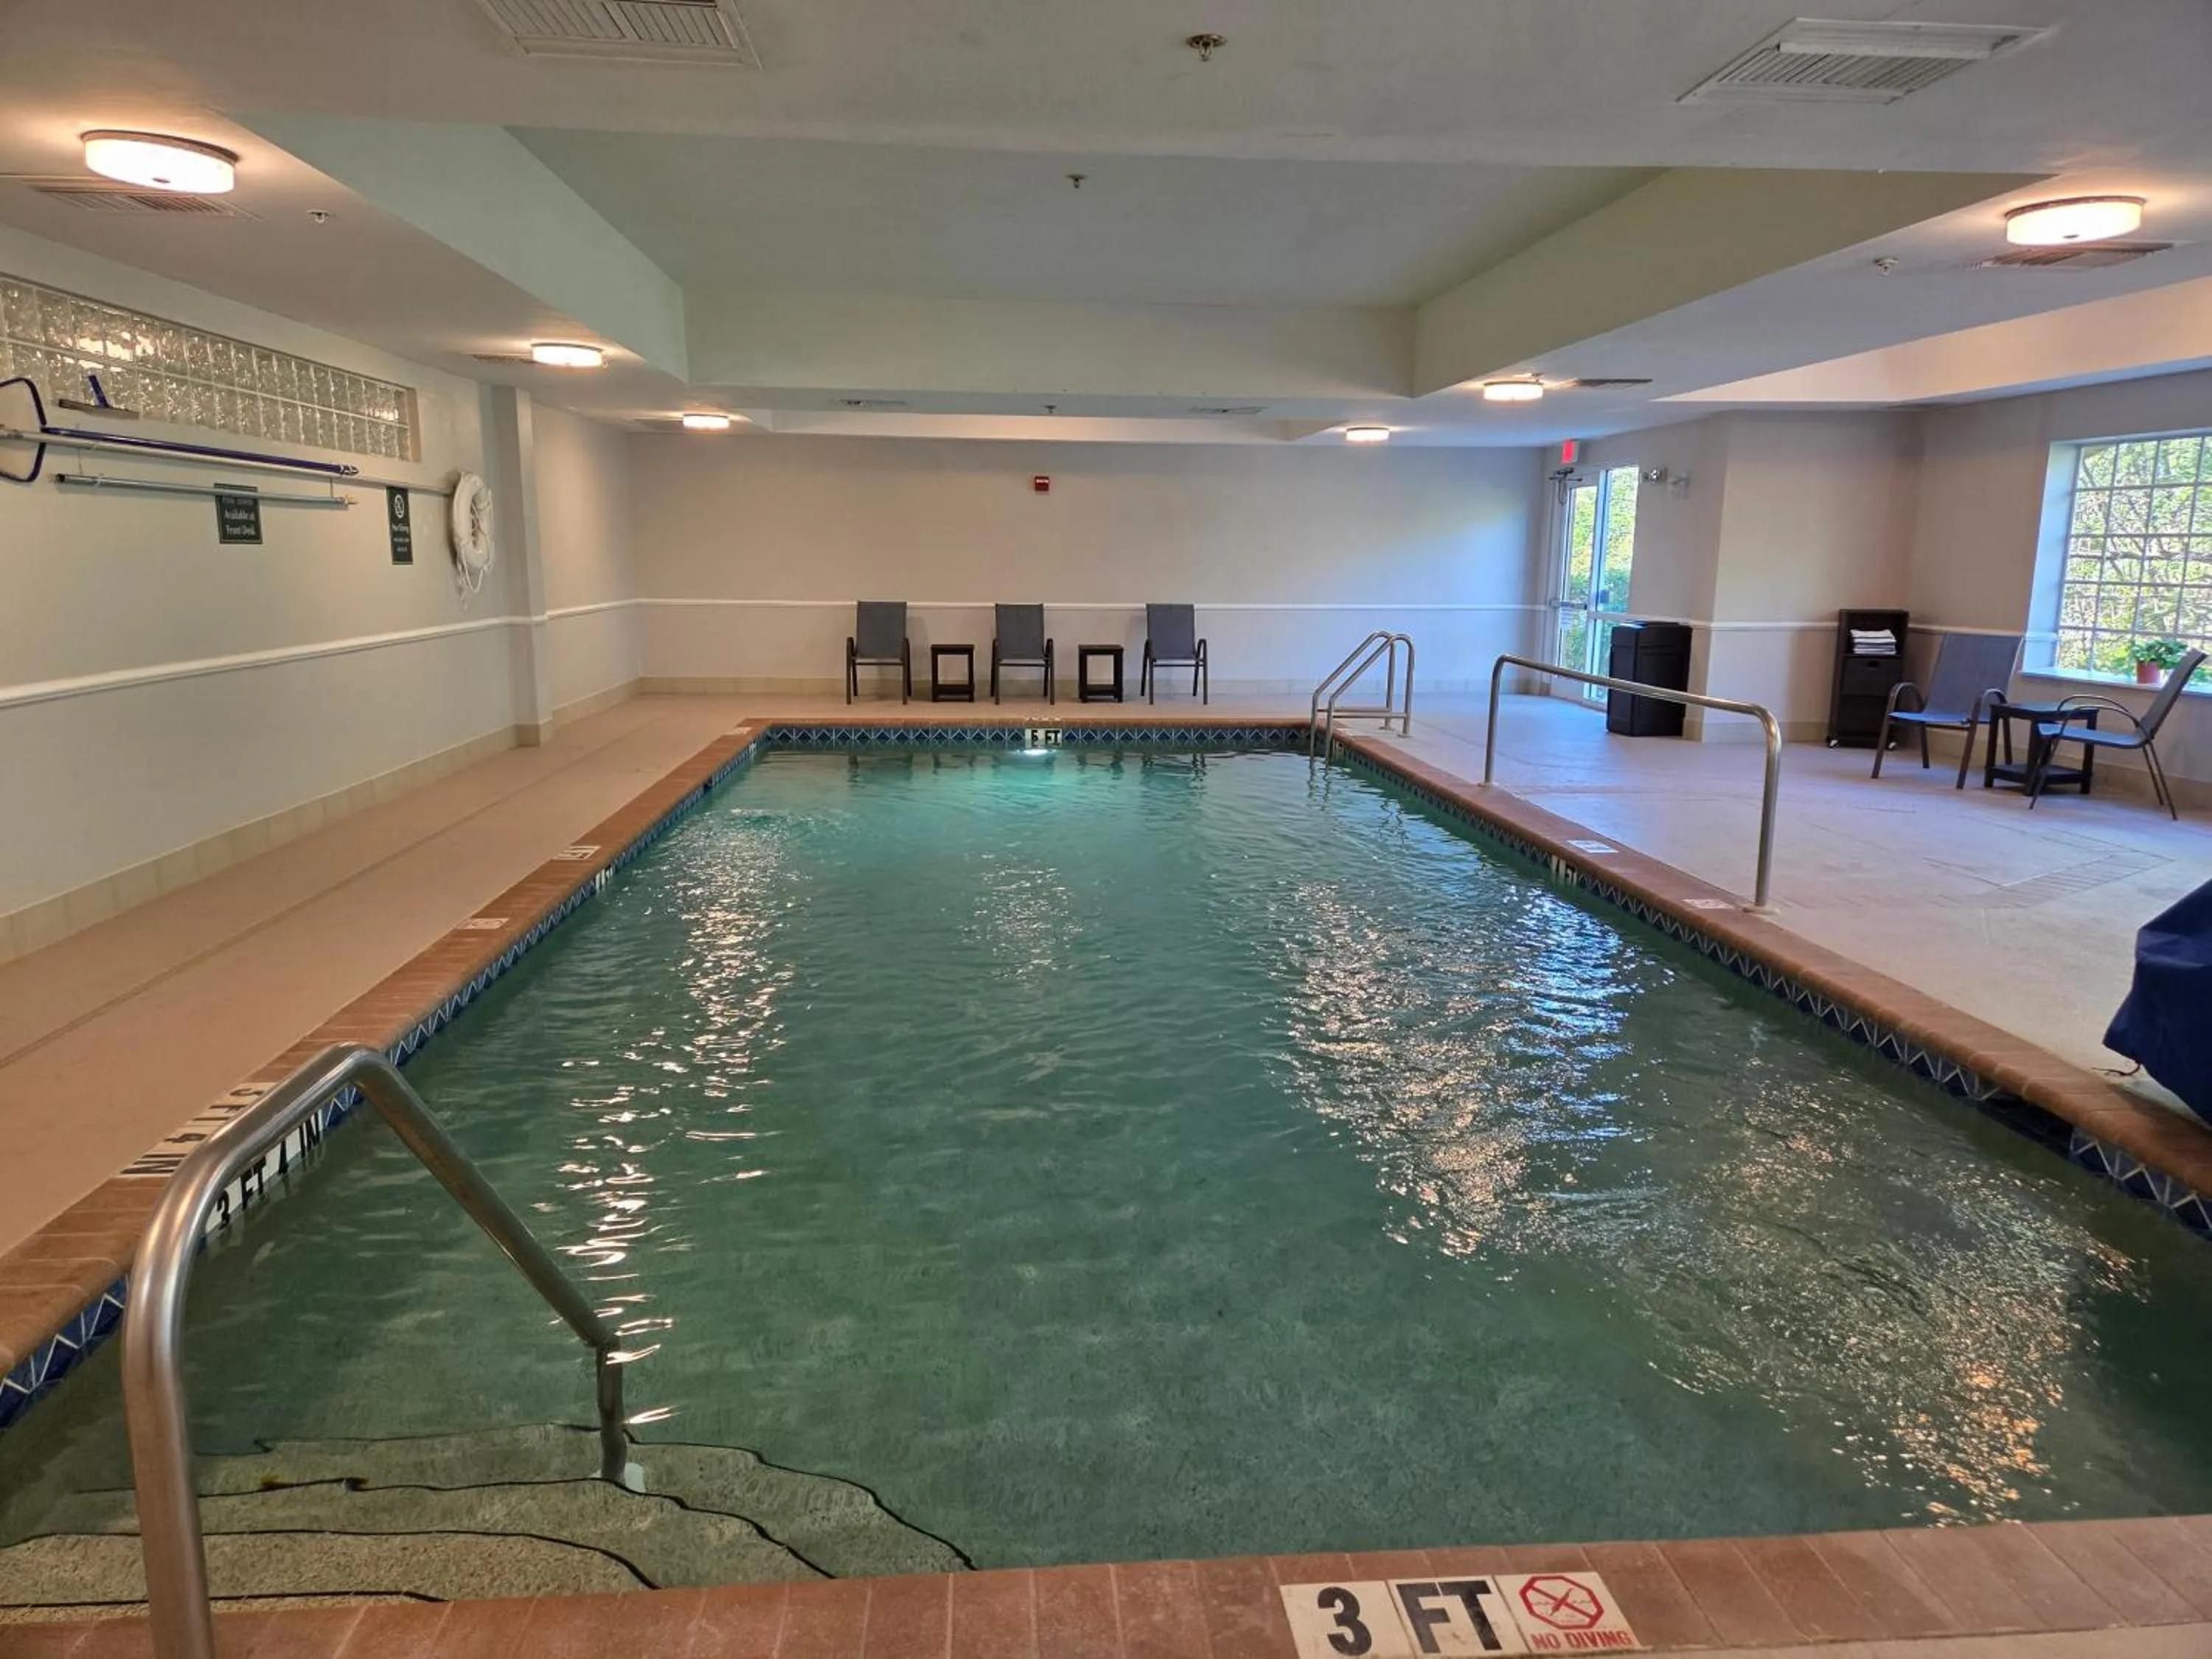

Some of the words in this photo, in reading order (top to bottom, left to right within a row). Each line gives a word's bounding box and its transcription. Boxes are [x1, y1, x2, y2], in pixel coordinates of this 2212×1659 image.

[1046, 729, 1060, 745] FT
[217, 1189, 231, 1231] 3
[240, 1155, 267, 1211] FT
[299, 1110, 320, 1158] IN
[1318, 1586, 1372, 1656] 3
[1396, 1579, 1503, 1654] FT
[1530, 1632, 1562, 1649] NO
[1563, 1630, 1634, 1649] DIVING
